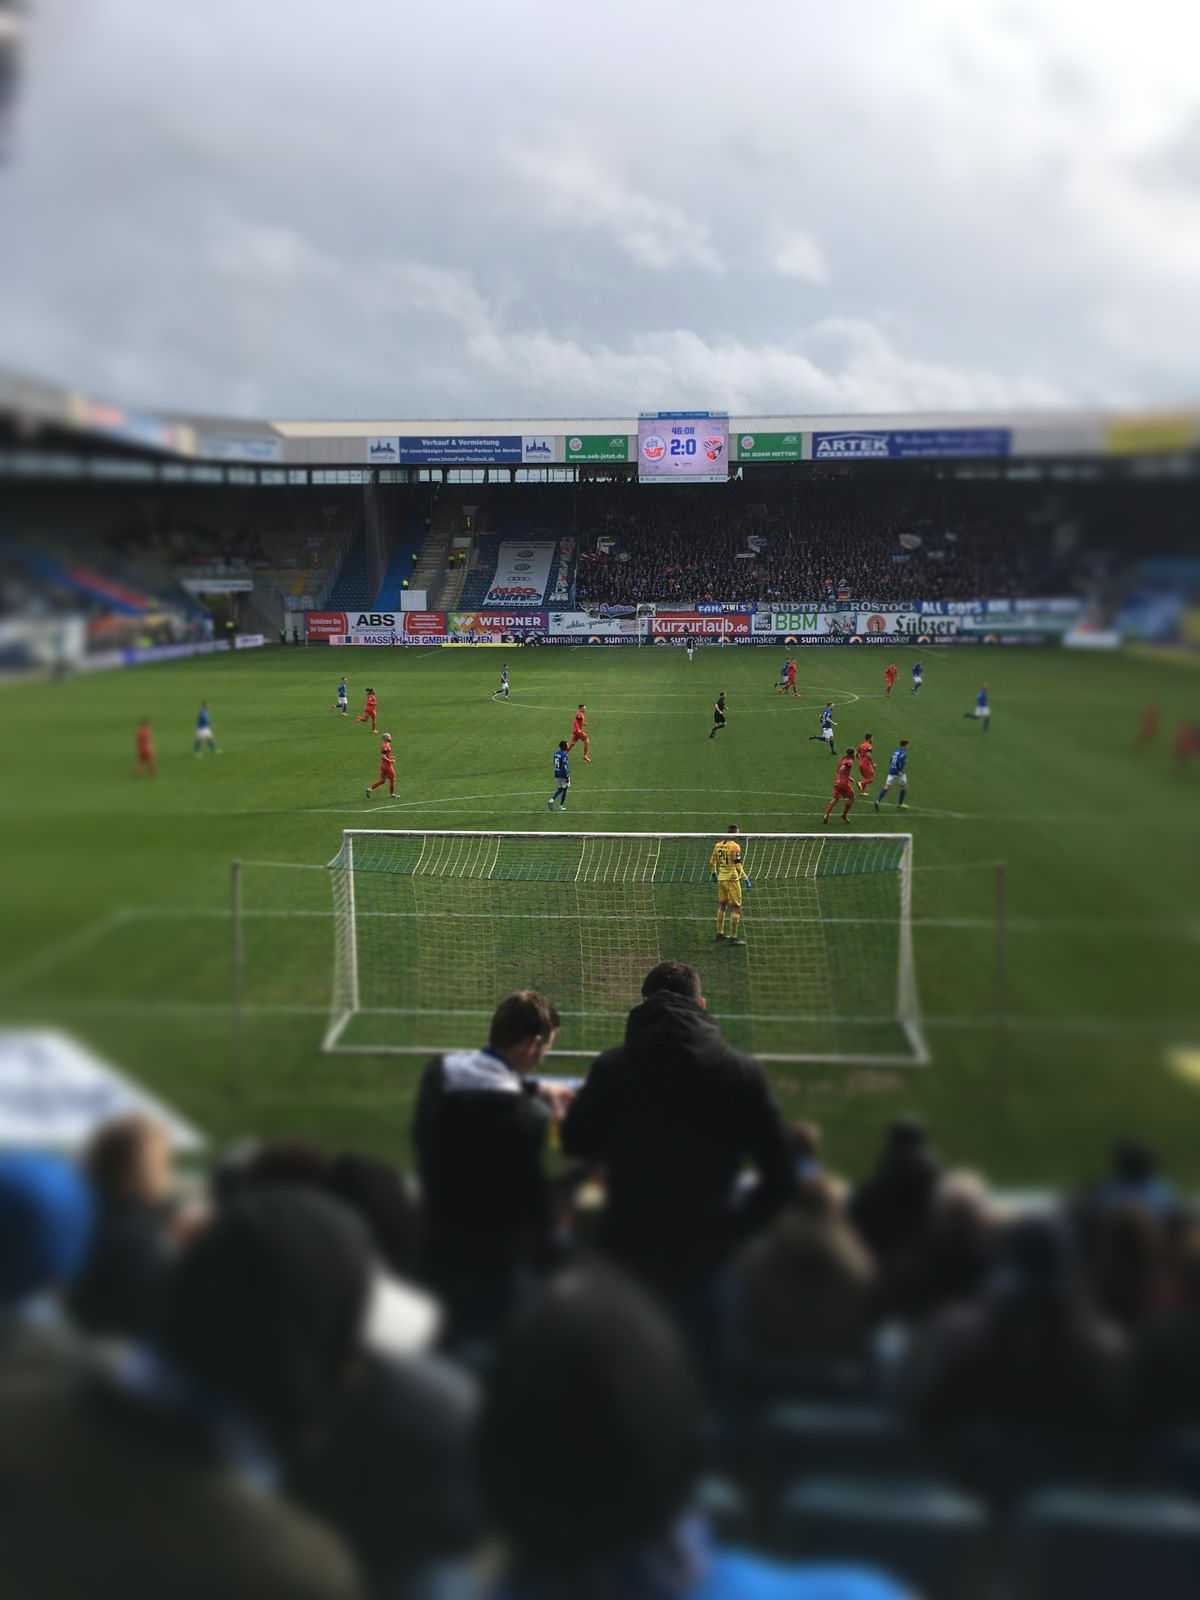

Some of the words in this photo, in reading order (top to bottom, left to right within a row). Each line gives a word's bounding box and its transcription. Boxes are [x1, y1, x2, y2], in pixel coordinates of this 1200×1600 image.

[421, 439, 449, 447] Verkauf
[458, 439, 500, 448] Vermietung
[670, 438, 697, 456] 2:0
[817, 439, 889, 451] ARTEK
[356, 614, 395, 627] ABS
[479, 616, 542, 626] WEIDNER
[652, 618, 749, 633] Kurzurlaub.de
[775, 613, 818, 631] BBM
[893, 615, 955, 635] Lübzer
[542, 636, 583, 644] sunmaker
[734, 636, 776, 644] sunmaker
[865, 636, 910, 644] sunmaker
